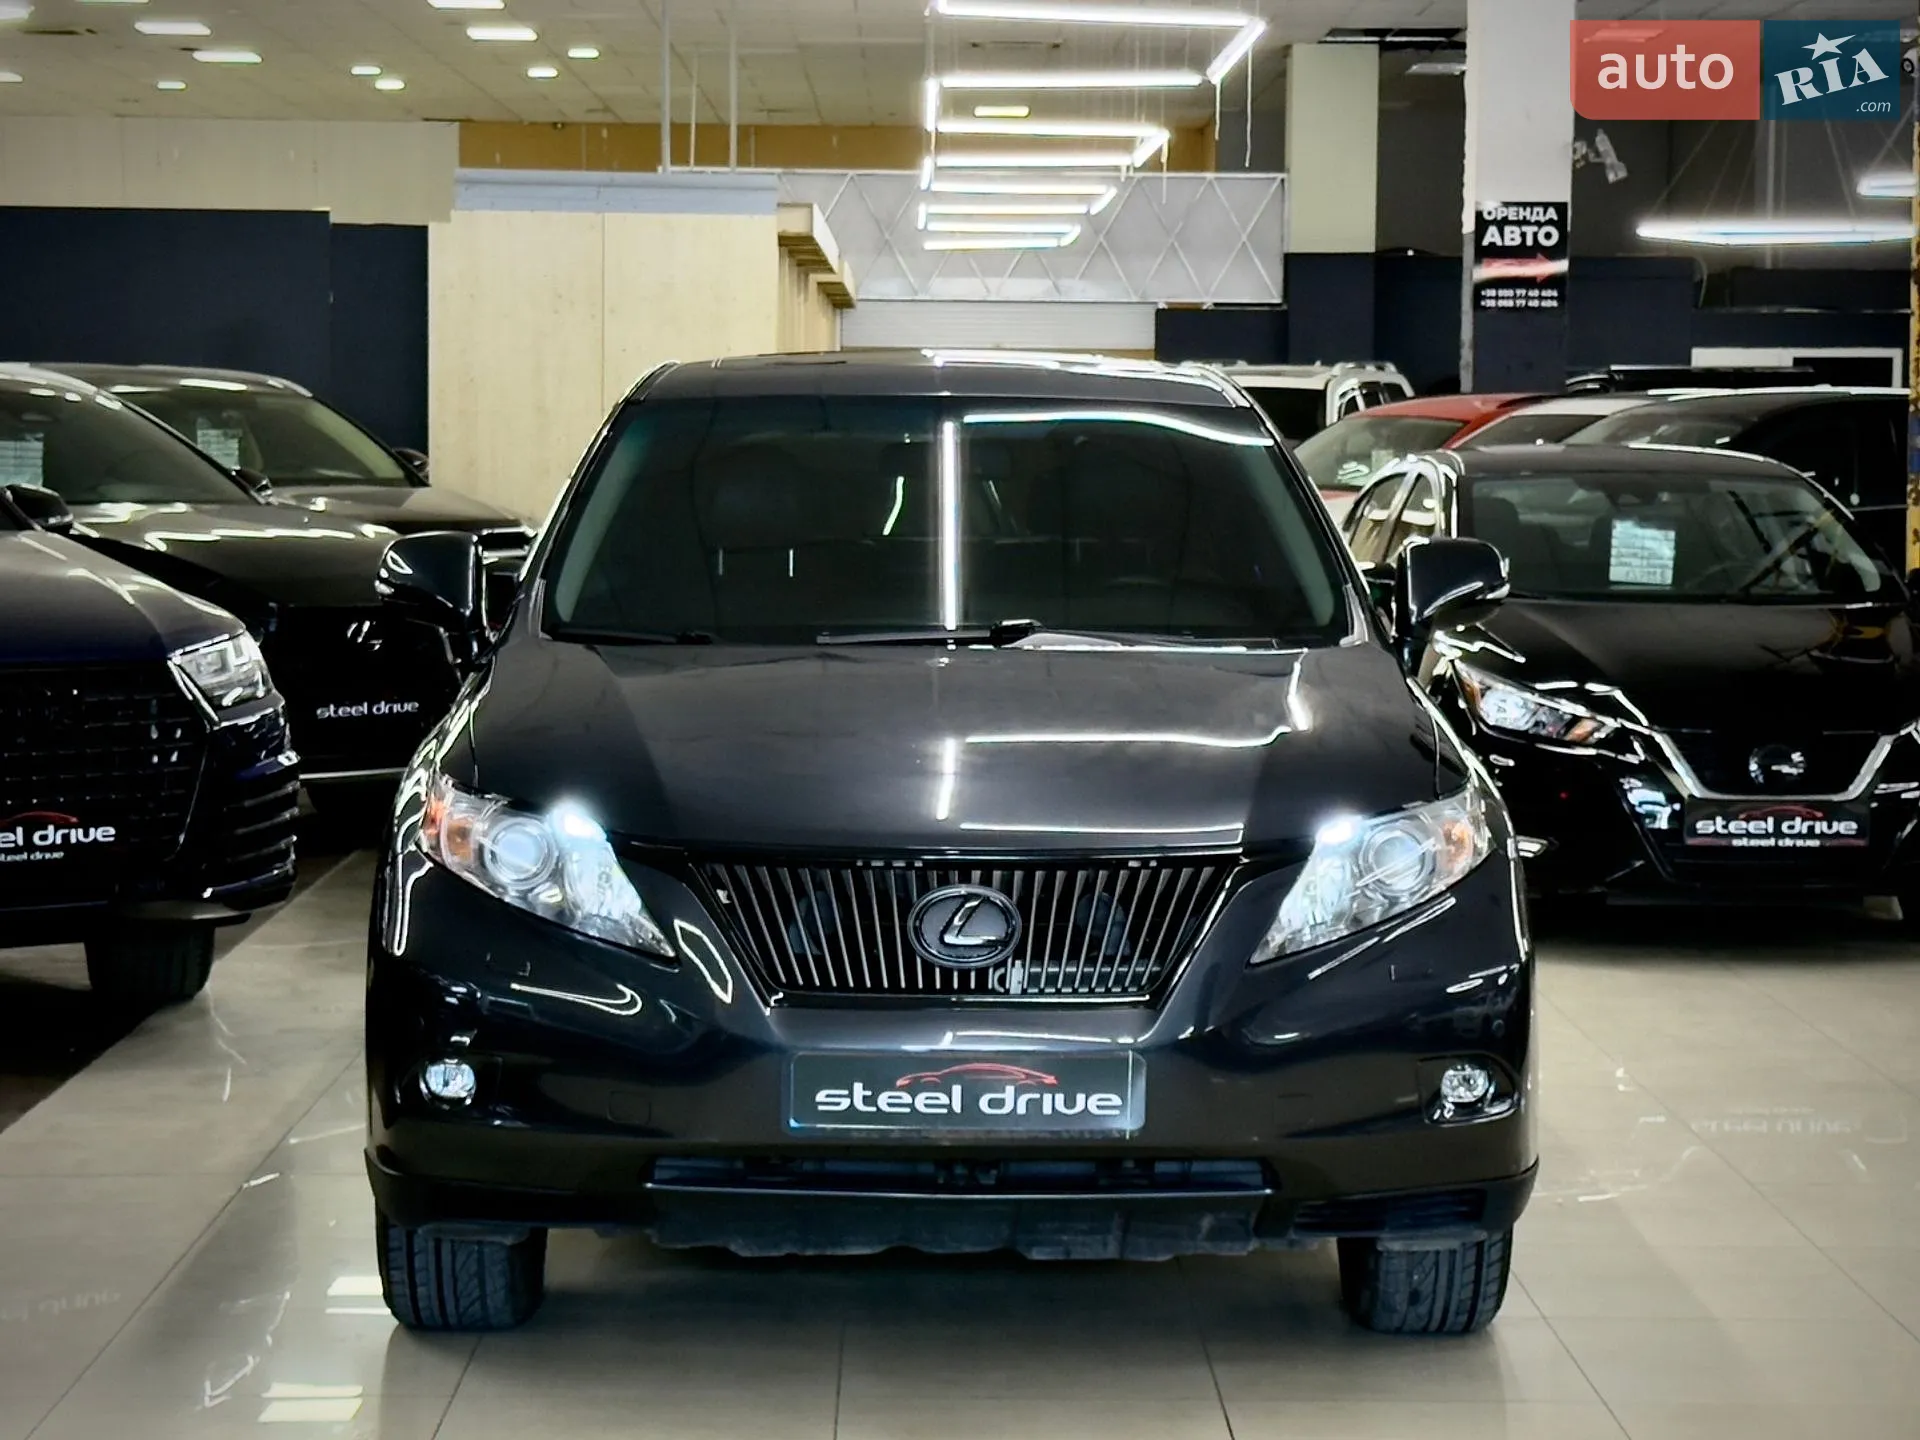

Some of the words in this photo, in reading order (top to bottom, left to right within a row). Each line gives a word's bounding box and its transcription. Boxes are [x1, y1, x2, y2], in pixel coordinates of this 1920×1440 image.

[1482, 206, 1558, 223] ОРЕНДА
[1481, 225, 1560, 247] АВТО
[316, 701, 368, 719] steel
[372, 700, 419, 715] drive
[32, 824, 116, 846] drive
[1695, 816, 1775, 835] steel
[1780, 816, 1858, 835] drive
[1731, 837, 1776, 848] steel
[1777, 837, 1821, 848] drive
[815, 1082, 962, 1113] steel
[978, 1085, 1123, 1115] drive
